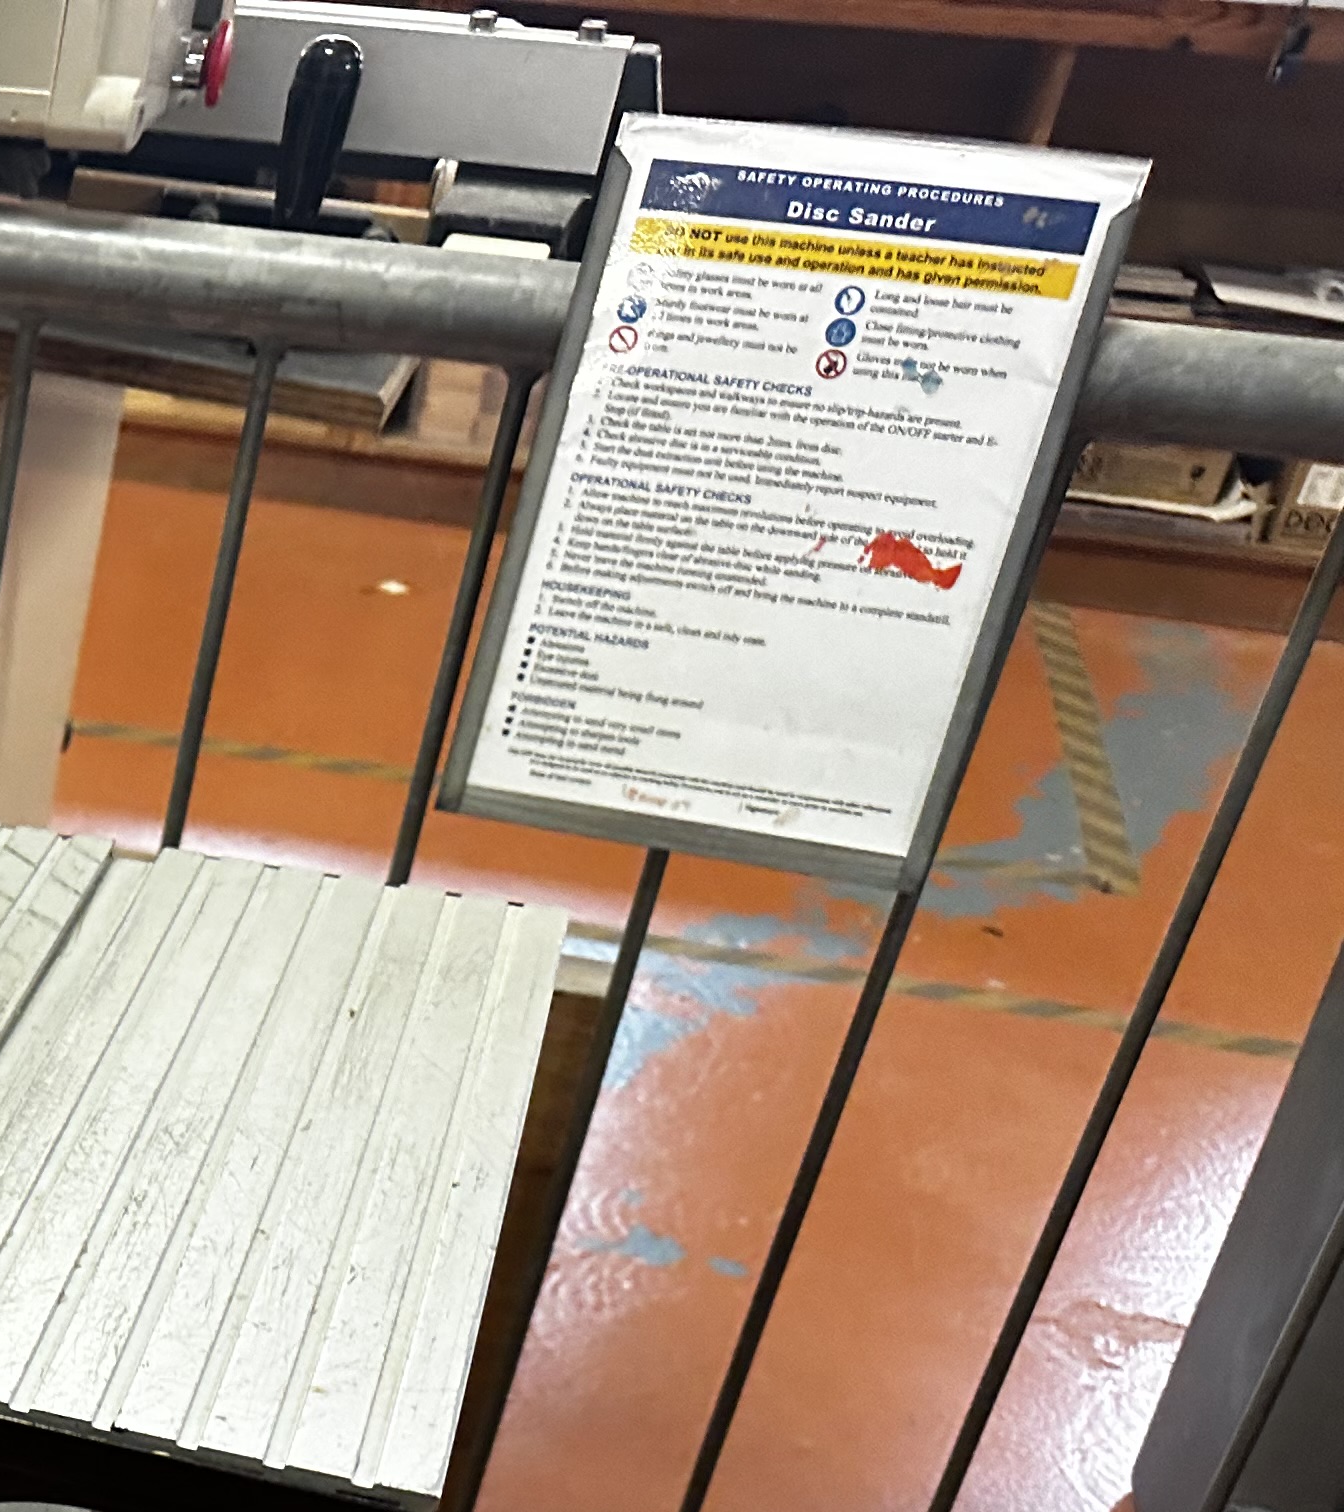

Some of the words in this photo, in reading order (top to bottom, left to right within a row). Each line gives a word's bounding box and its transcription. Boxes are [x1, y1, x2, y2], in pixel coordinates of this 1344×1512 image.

[735, 169, 797, 187] SAFETY
[800, 175, 893, 196] OPERATING
[896, 185, 1005, 207] PROCEDURES
[785, 200, 842, 223] Disc
[846, 206, 938, 232] Sander
[682, 244, 697, 257] in
[697, 245, 716, 260] its
[716, 247, 746, 263] safe
[746, 251, 773, 266] use
[773, 254, 801, 269] and
[801, 256, 866, 276] operation
[866, 263, 894, 279] and
[894, 266, 922, 282] has
[922, 269, 962, 286] given
[688, 227, 722, 242] NOT
[724, 231, 750, 245] use
[751, 234, 777, 247] this
[778, 236, 836, 254] machine
[836, 243, 883, 259] unless
[883, 247, 894, 260] a
[894, 249, 947, 266] teacher
[948, 254, 975, 269] has
[711, 374, 760, 390] SAFETY
[761, 380, 813, 397] CHECKS
